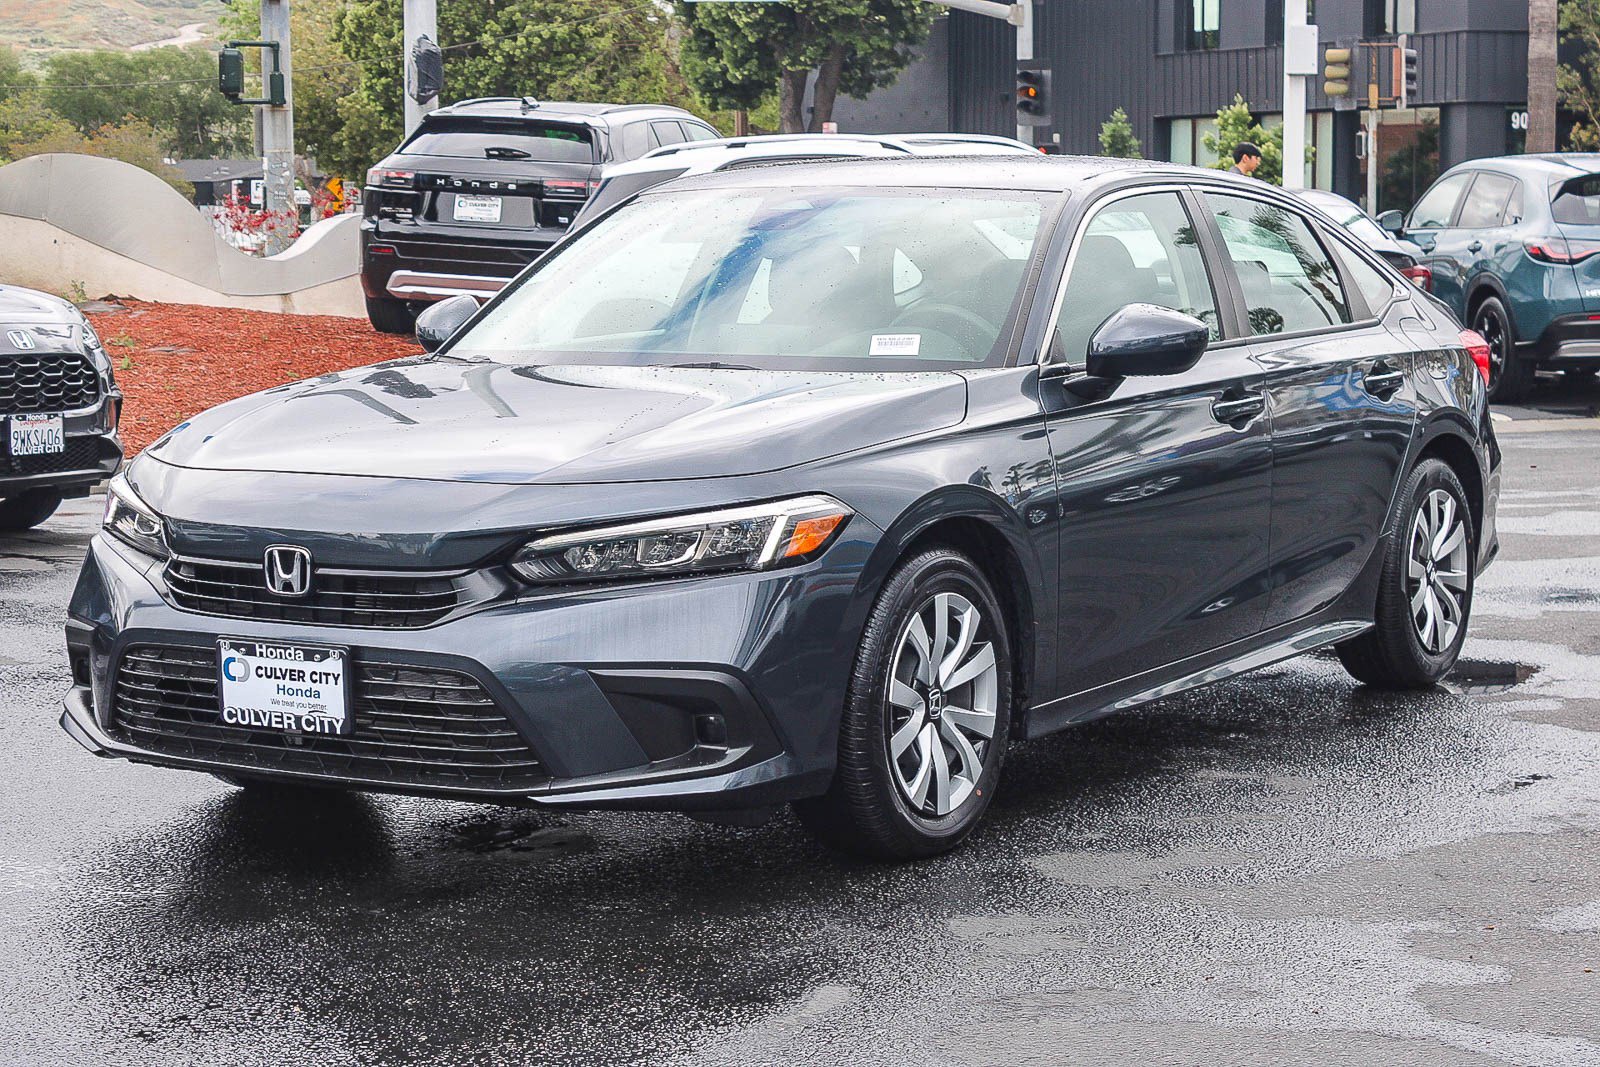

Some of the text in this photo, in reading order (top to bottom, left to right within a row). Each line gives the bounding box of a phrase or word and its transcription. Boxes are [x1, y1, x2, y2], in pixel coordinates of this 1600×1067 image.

[26, 413, 48, 421] Honda
[12, 444, 64, 456] CULVER CITY
[255, 643, 304, 661] Honda
[255, 666, 341, 686] CULVER CITY
[276, 684, 321, 699] Honda
[270, 698, 281, 706] We
[281, 699, 295, 707] treat
[222, 708, 344, 735] CULVER CITY
